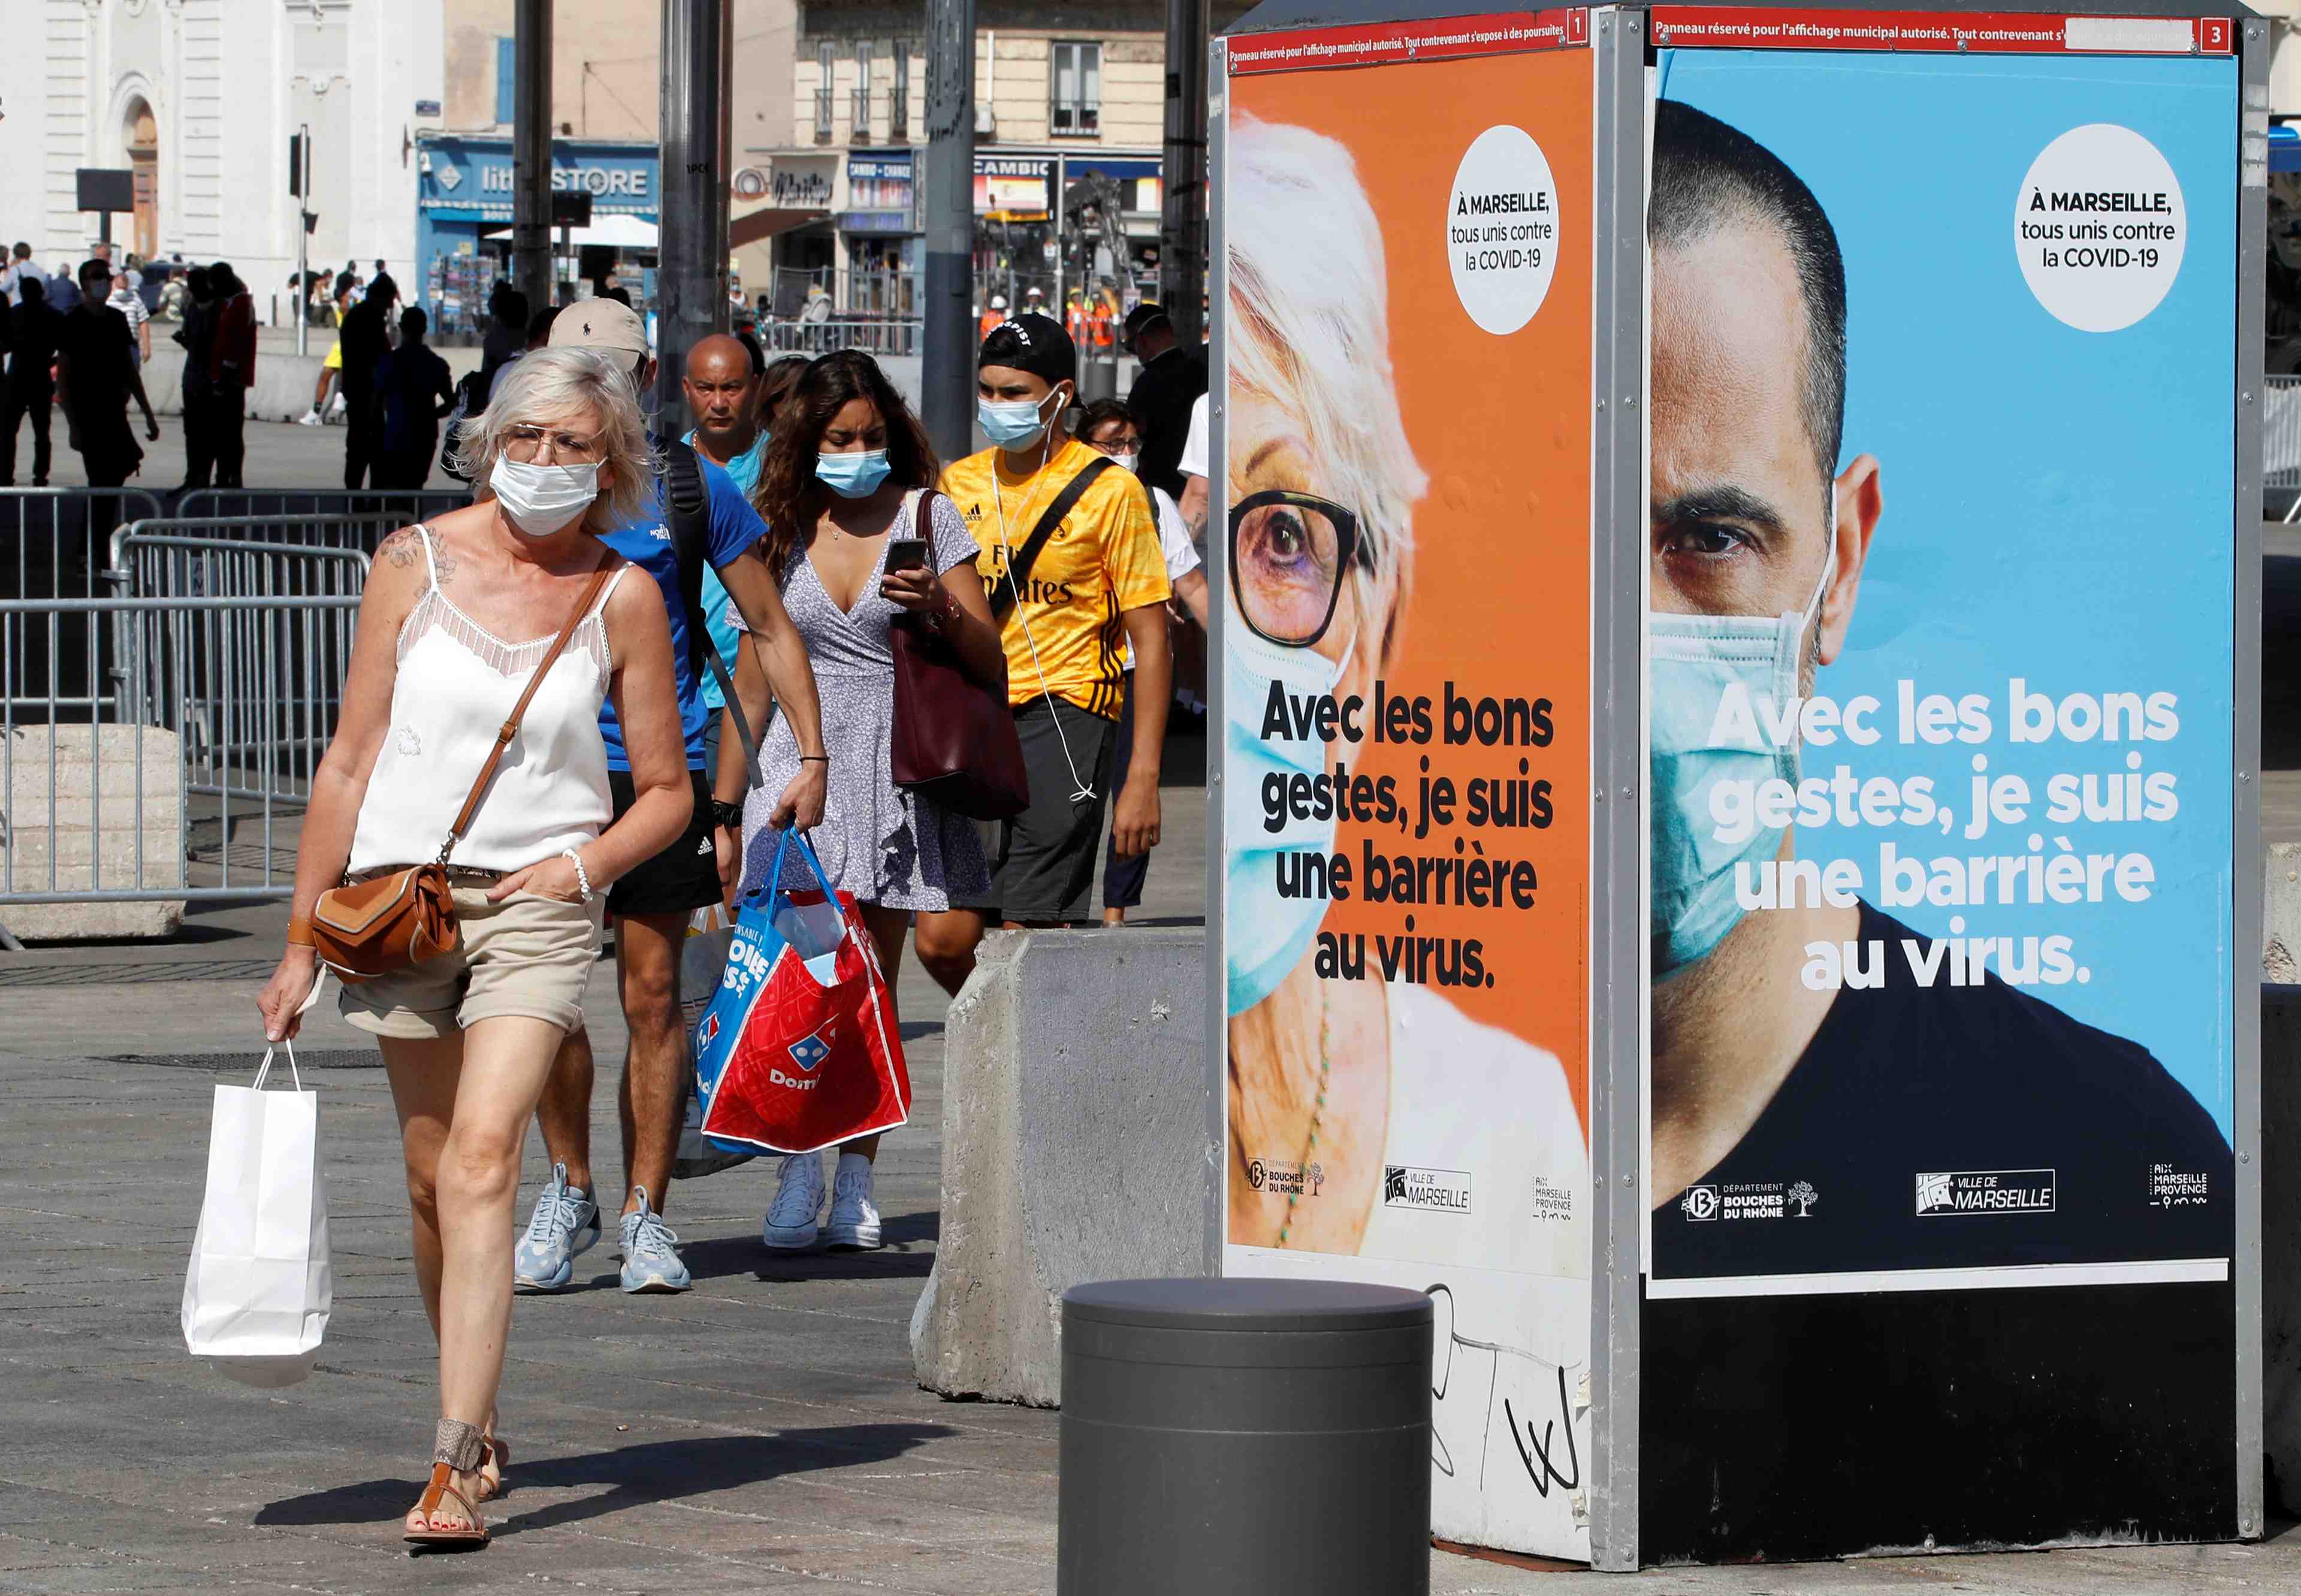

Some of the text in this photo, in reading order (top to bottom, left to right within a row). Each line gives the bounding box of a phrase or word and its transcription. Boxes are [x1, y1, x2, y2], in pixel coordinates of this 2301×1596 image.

[1574, 17, 1581, 34] 1
[1655, 22, 1705, 35] Panneau
[1708, 22, 1750, 35] réservé
[1753, 26, 1780, 38] pour
[1783, 23, 1840, 39] l'affichage
[1843, 25, 1898, 40] municipal
[1901, 26, 1950, 40] autorisé.
[1952, 28, 1977, 40] Tout
[1979, 29, 2054, 41] contrevenant
[2211, 26, 2221, 43] 3
[1230, 24, 1564, 63] Panneau réservé pour l'affichage municipal autorisé. Tout contrevenant s'expose à des poursuites
[551, 167, 648, 195] STORE
[1457, 191, 1550, 216] À MARSEILLE,
[2030, 186, 2172, 215] À MARSEILLE,
[1451, 221, 1552, 243] tous unis contre
[2021, 219, 2175, 240] tous unis contre
[1466, 248, 1541, 271] la COVID-19
[2043, 247, 2158, 268] la COVID-19
[1260, 679, 1554, 748] Avec les bons
[1707, 677, 2179, 746] Avec les bons
[1261, 754, 1554, 839] gestes, je suis
[1708, 751, 2179, 845] gestes, je suis
[1276, 836, 1538, 909] une barrière
[1734, 833, 2155, 910] une barrière
[1315, 914, 1495, 989] au virus.
[1800, 915, 2091, 992] au virus.
[1269, 1171, 1304, 1183] BOUCHES
[1409, 1172, 1435, 1184] VILLE DE
[1723, 1183, 1784, 1193] DÉPARTEMENT
[1958, 1177, 1998, 1189] VILLE DE
[1269, 1182, 1304, 1195] DU RHÔNE
[1408, 1186, 1469, 1208] MARSEILLE
[1955, 1188, 2052, 1210] MARSEILLE
[2154, 1184, 2207, 1195] PROVENCE
[1535, 1199, 1572, 1211] PROVENCE
[1723, 1195, 1784, 1207] BOUCHES
[1723, 1205, 1784, 1220] DU RHÔNE
